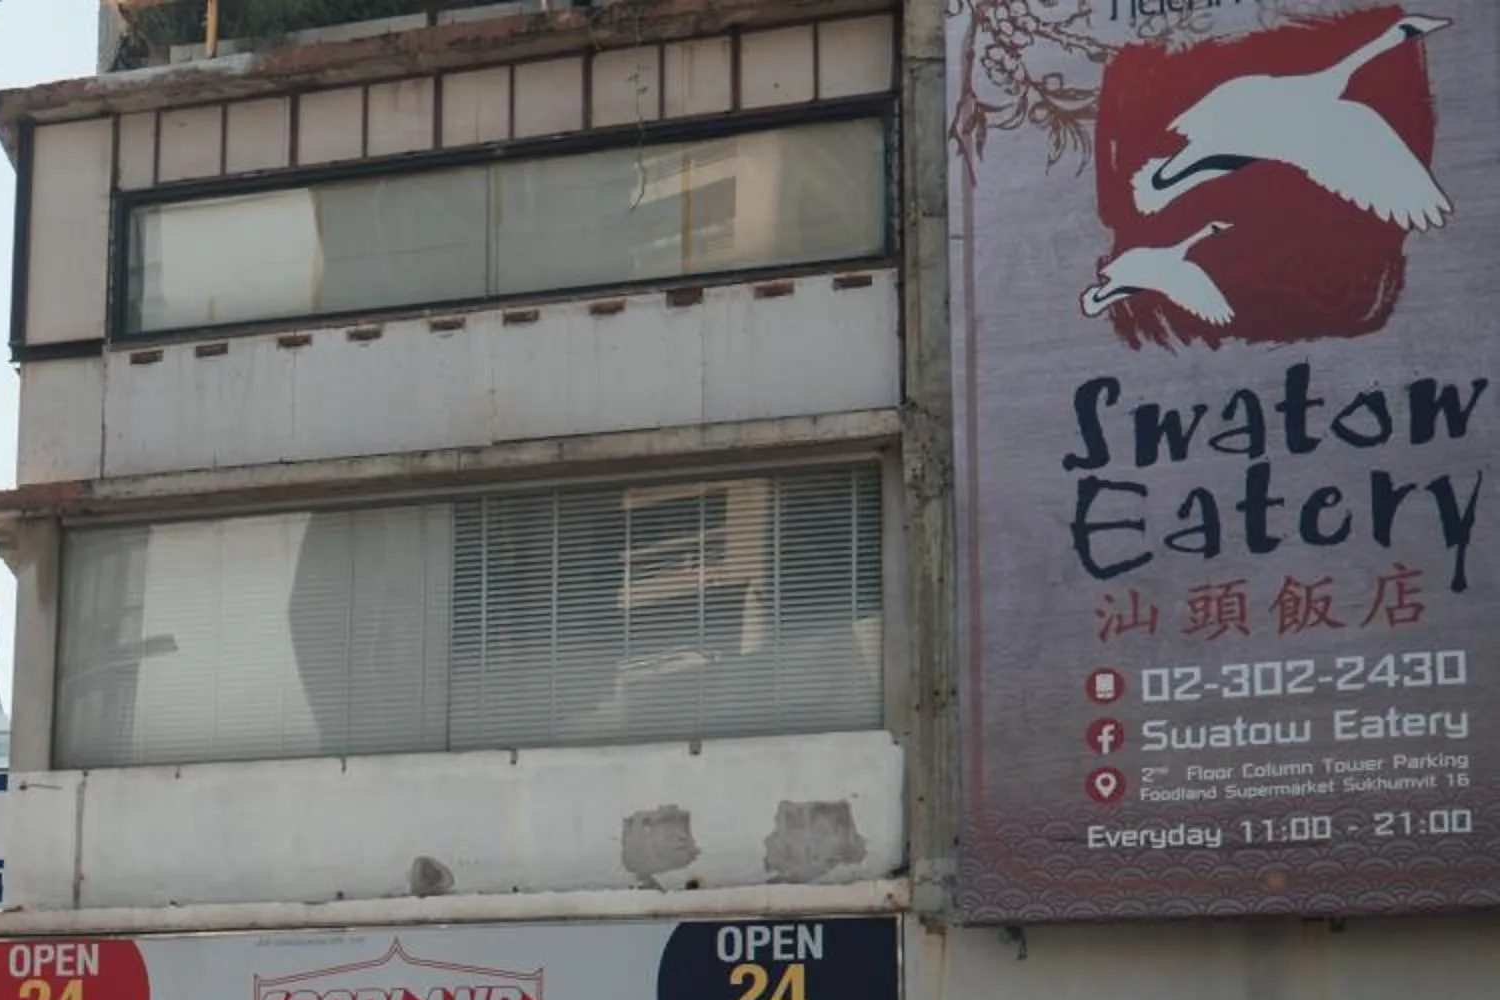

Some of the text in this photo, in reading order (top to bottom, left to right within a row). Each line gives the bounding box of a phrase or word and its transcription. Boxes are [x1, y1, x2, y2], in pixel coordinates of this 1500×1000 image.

[1062, 356, 1488, 472] Swatow
[1070, 458, 1482, 592] Eatery
[1095, 562, 1427, 642] 汕頭飯店
[1140, 650, 1467, 702] 02-302-2430
[1140, 716, 1313, 751] Swatow
[1333, 705, 1469, 743] Eatery
[1139, 772, 1471, 802] Foodland Supermarket Sukhumvit 16
[1187, 765, 1233, 781] Floor
[1242, 759, 1314, 778] Column
[1322, 756, 1384, 773] Tower
[1392, 752, 1470, 772] Parking
[1087, 823, 1222, 849] Everyday
[1239, 814, 1332, 844] 11:00
[1372, 808, 1473, 836] 21:00
[8, 943, 100, 978] OPEN
[716, 924, 824, 962] OPEN
